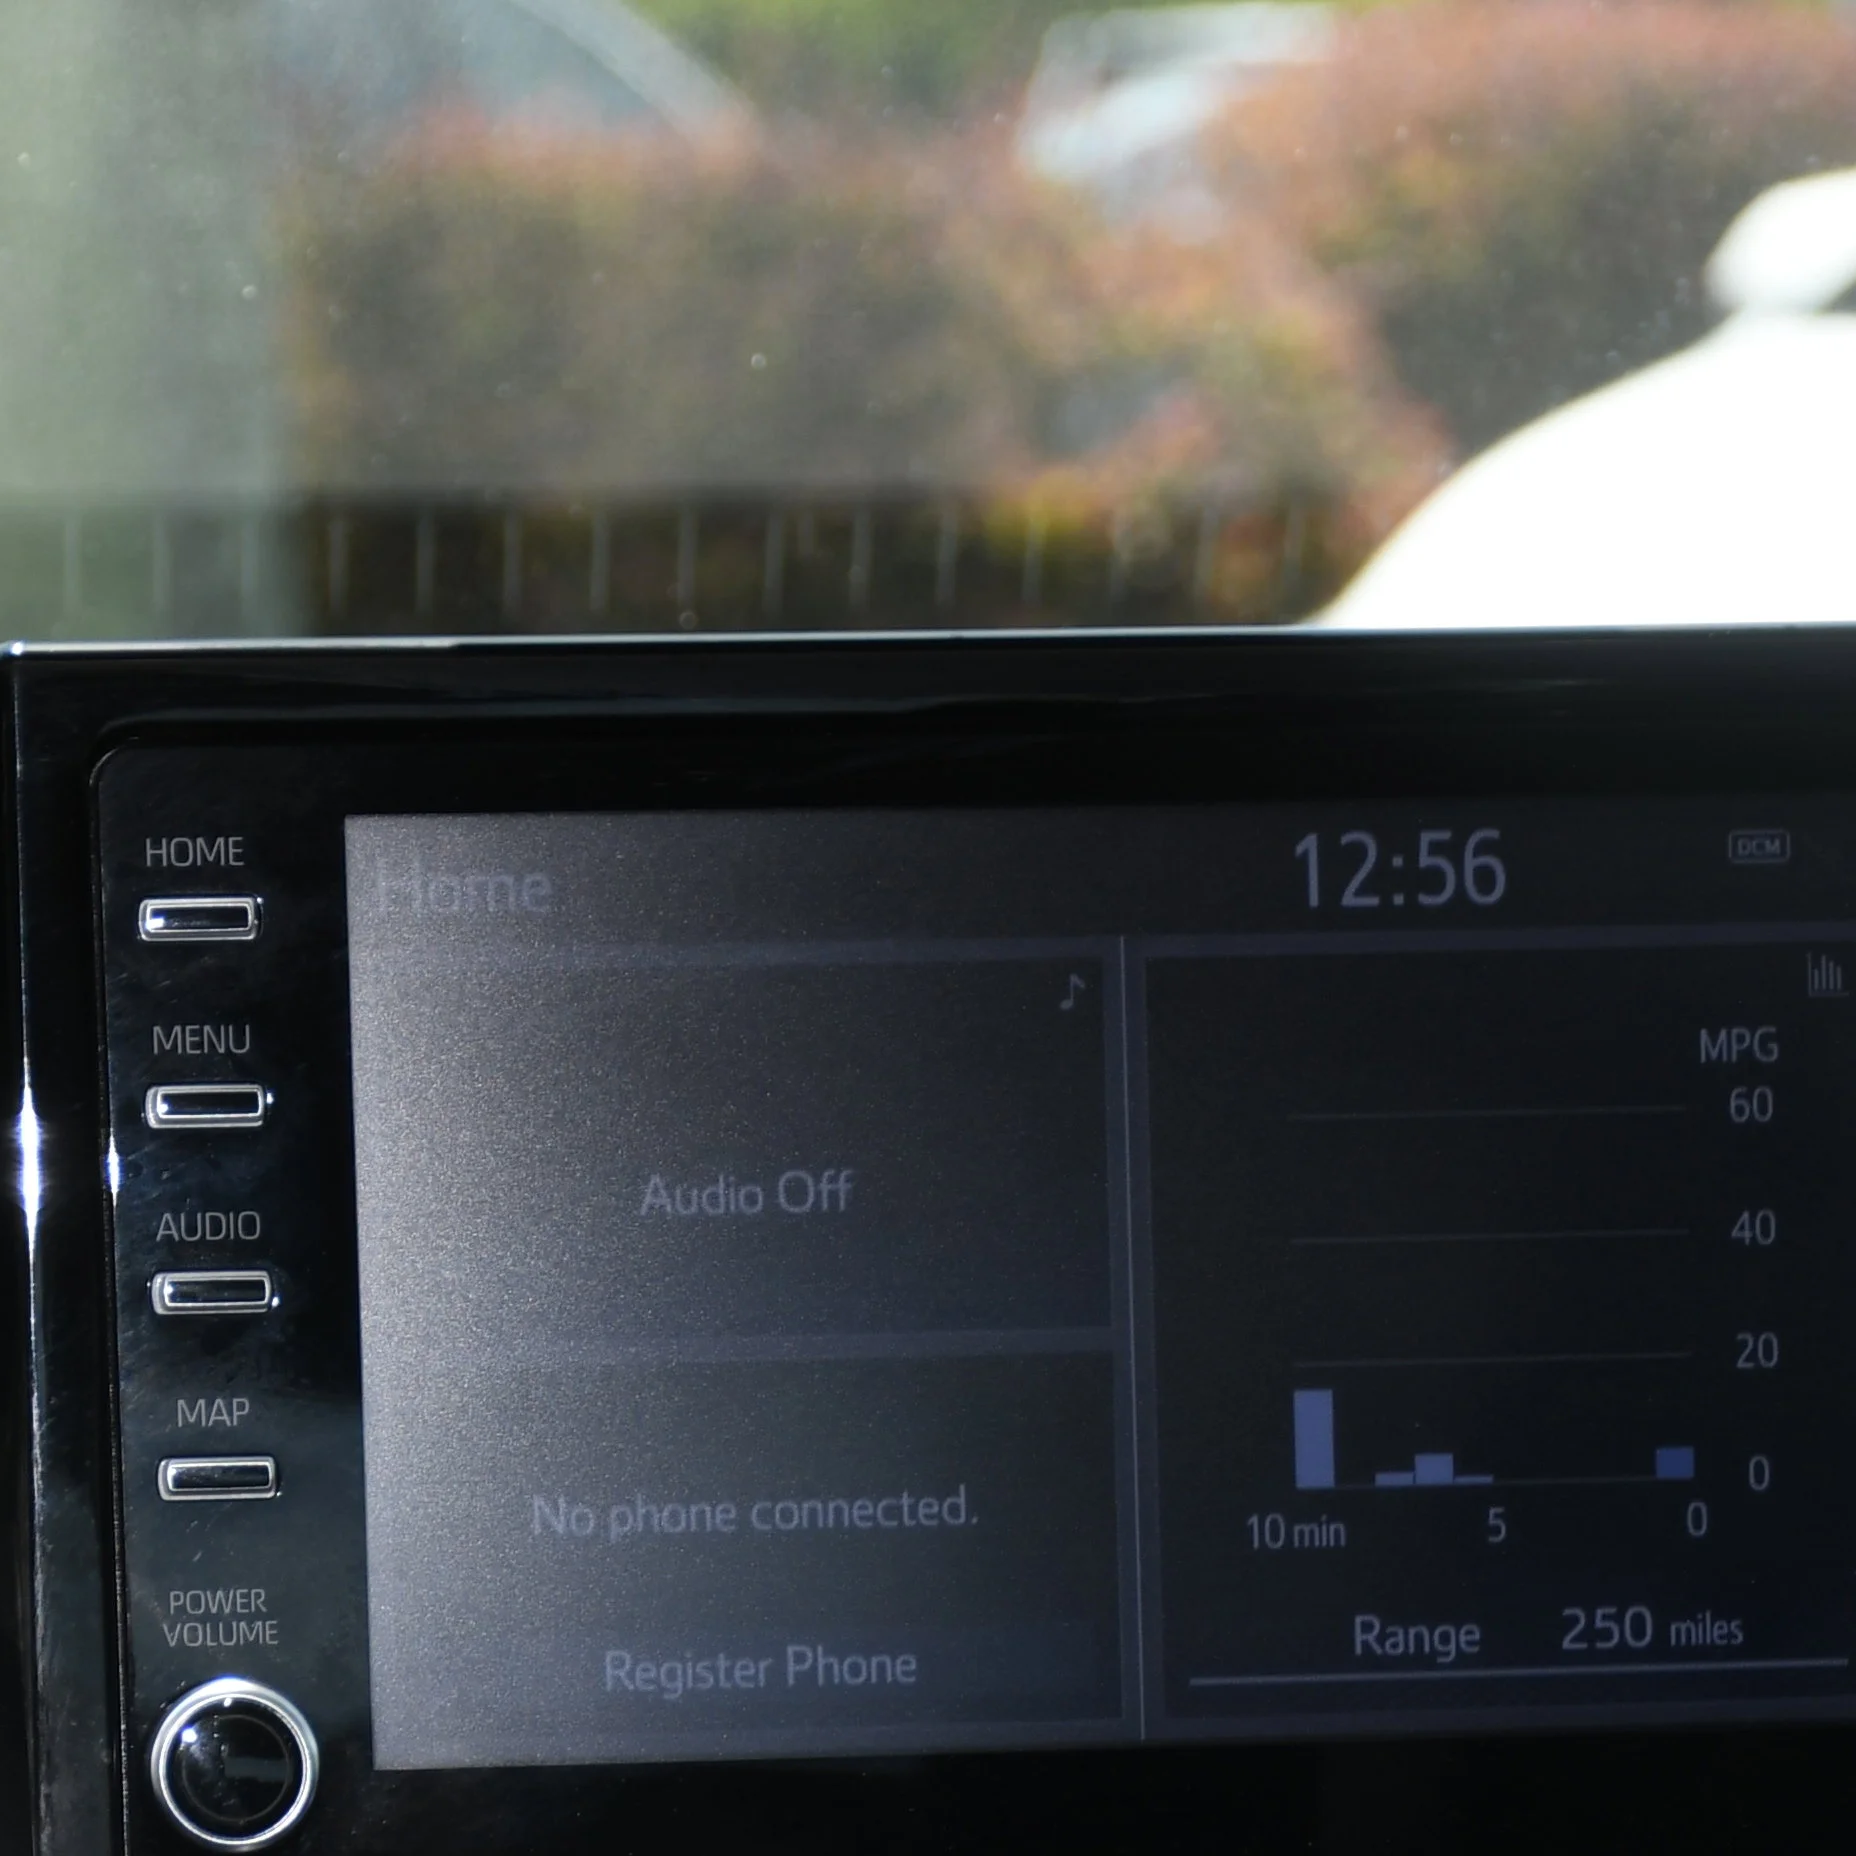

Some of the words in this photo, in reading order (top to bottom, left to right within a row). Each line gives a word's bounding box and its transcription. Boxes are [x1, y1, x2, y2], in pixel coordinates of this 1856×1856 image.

[145, 836, 245, 868] HOME
[1736, 836, 1782, 857] DCM
[377, 858, 554, 914] Home
[1293, 828, 1509, 909] 12:56
[152, 1023, 252, 1056] MENU
[1699, 1026, 1780, 1064] MPG
[1728, 1086, 1775, 1124] 60
[639, 1172, 764, 1218] Audio
[776, 1169, 855, 1213] Off
[156, 1210, 262, 1242] AUDIO
[1730, 1208, 1777, 1247] 40
[1734, 1332, 1779, 1370] 20
[176, 1398, 250, 1428] MAP
[1747, 1455, 1771, 1492] 0
[531, 1495, 596, 1537] No
[608, 1488, 737, 1543] phone
[750, 1484, 980, 1532] connected.
[1246, 1513, 1286, 1552] 10
[1292, 1514, 1347, 1550] min
[1486, 1506, 1508, 1544] 5
[1685, 1500, 1709, 1538] 0
[169, 1587, 268, 1615] POWER
[162, 1619, 279, 1648] VOLUME
[1353, 1614, 1482, 1663] Range
[1560, 1605, 1654, 1652] 250
[1669, 1611, 1744, 1649] miles
[603, 1648, 771, 1704] Register
[786, 1643, 918, 1686] Phone
